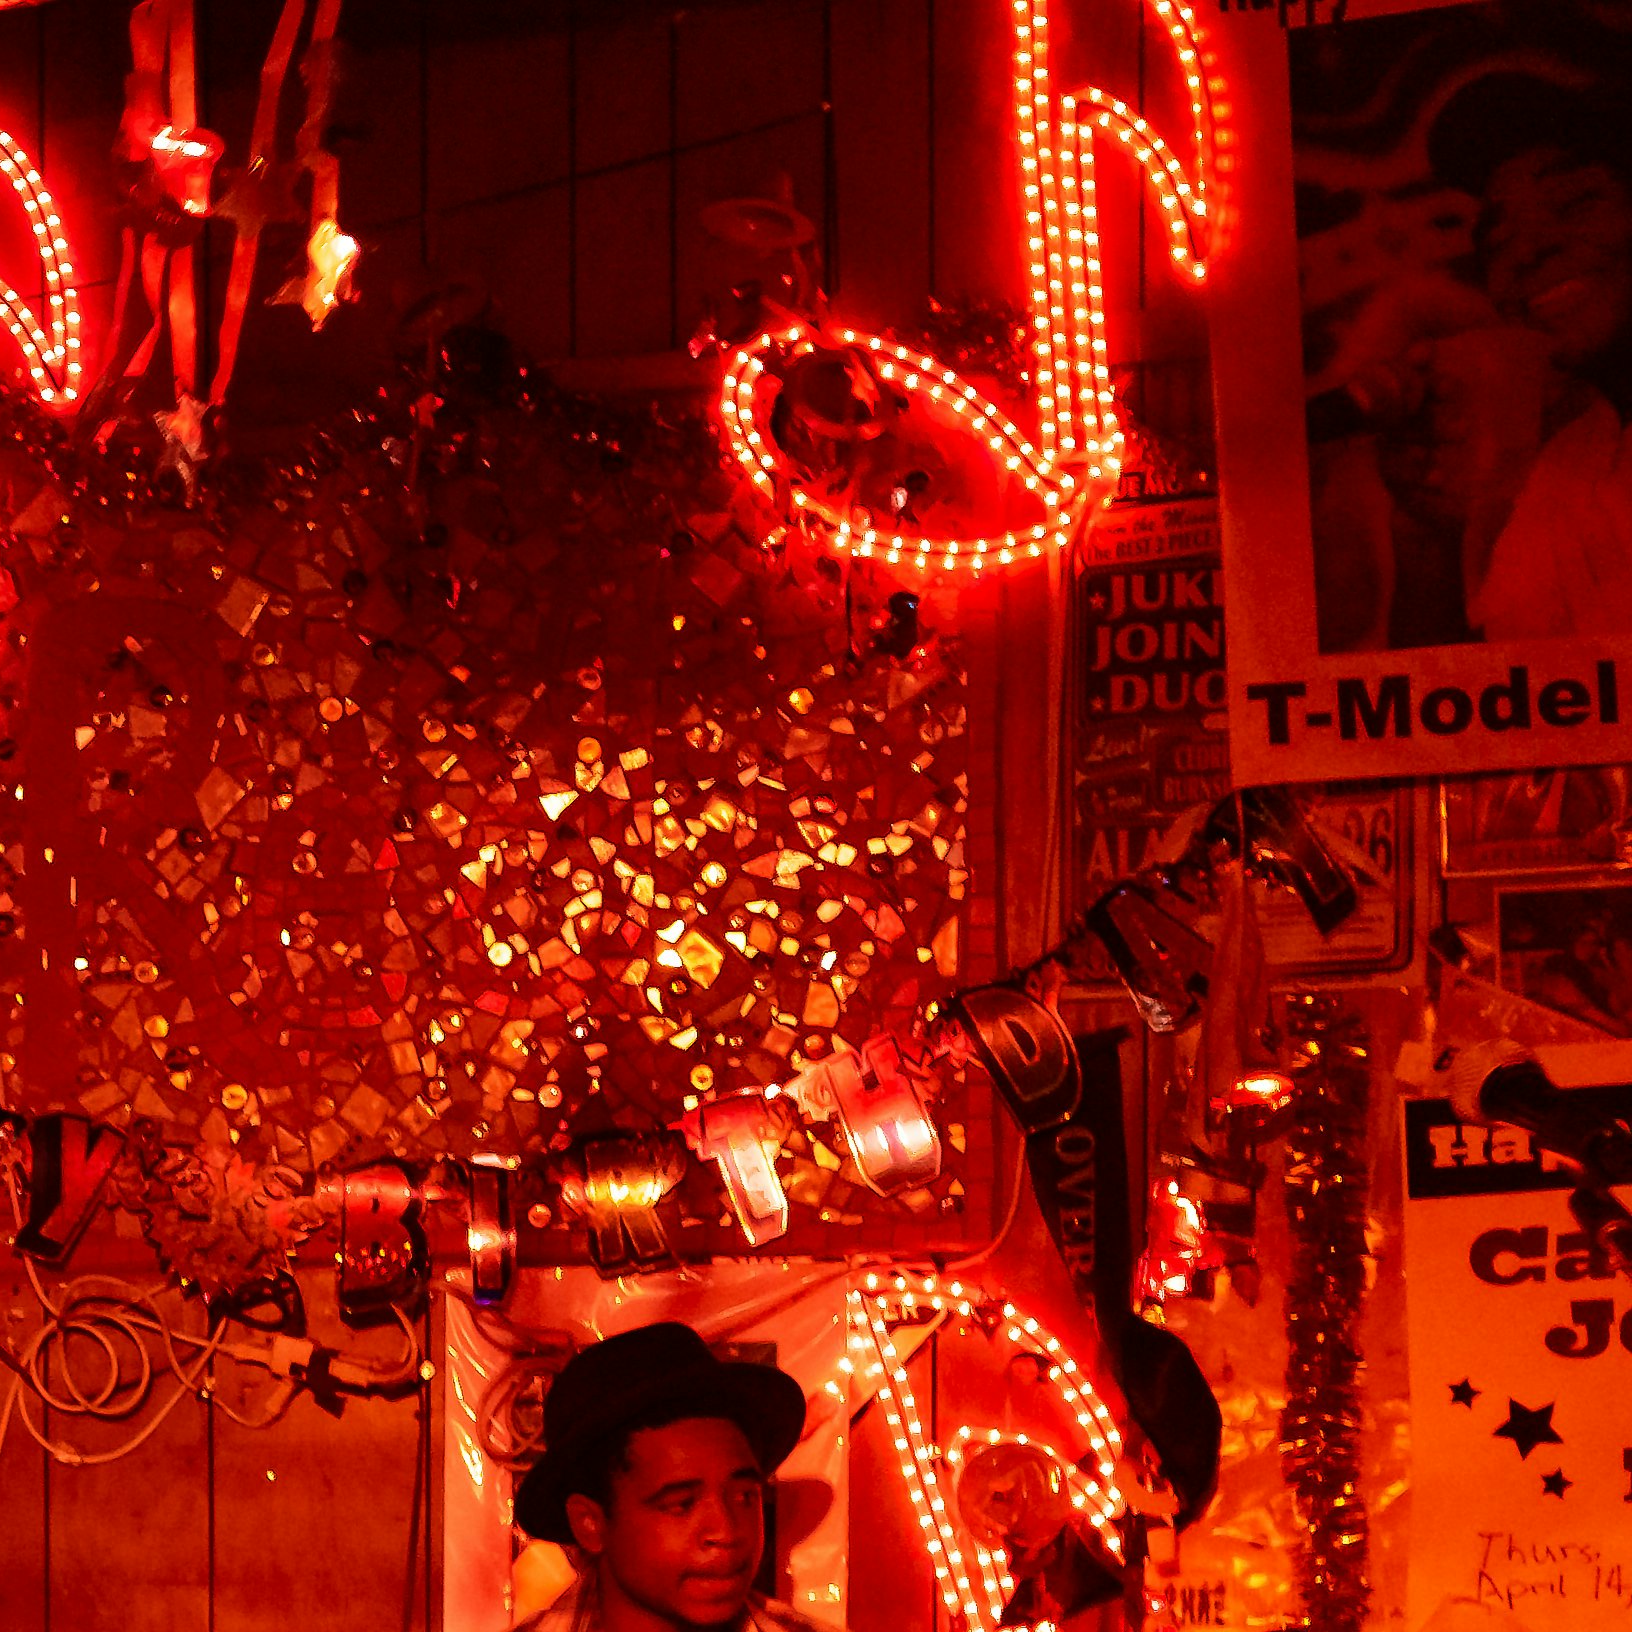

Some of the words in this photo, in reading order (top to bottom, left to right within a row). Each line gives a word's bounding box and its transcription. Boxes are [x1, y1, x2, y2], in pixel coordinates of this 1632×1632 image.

[1091, 619, 1221, 672] JOIN
[1247, 658, 1620, 746] T-Model
[1164, 774, 1230, 803] BURNS
[1544, 1297, 1632, 1359] J
[1458, 1567, 1566, 1611] April
